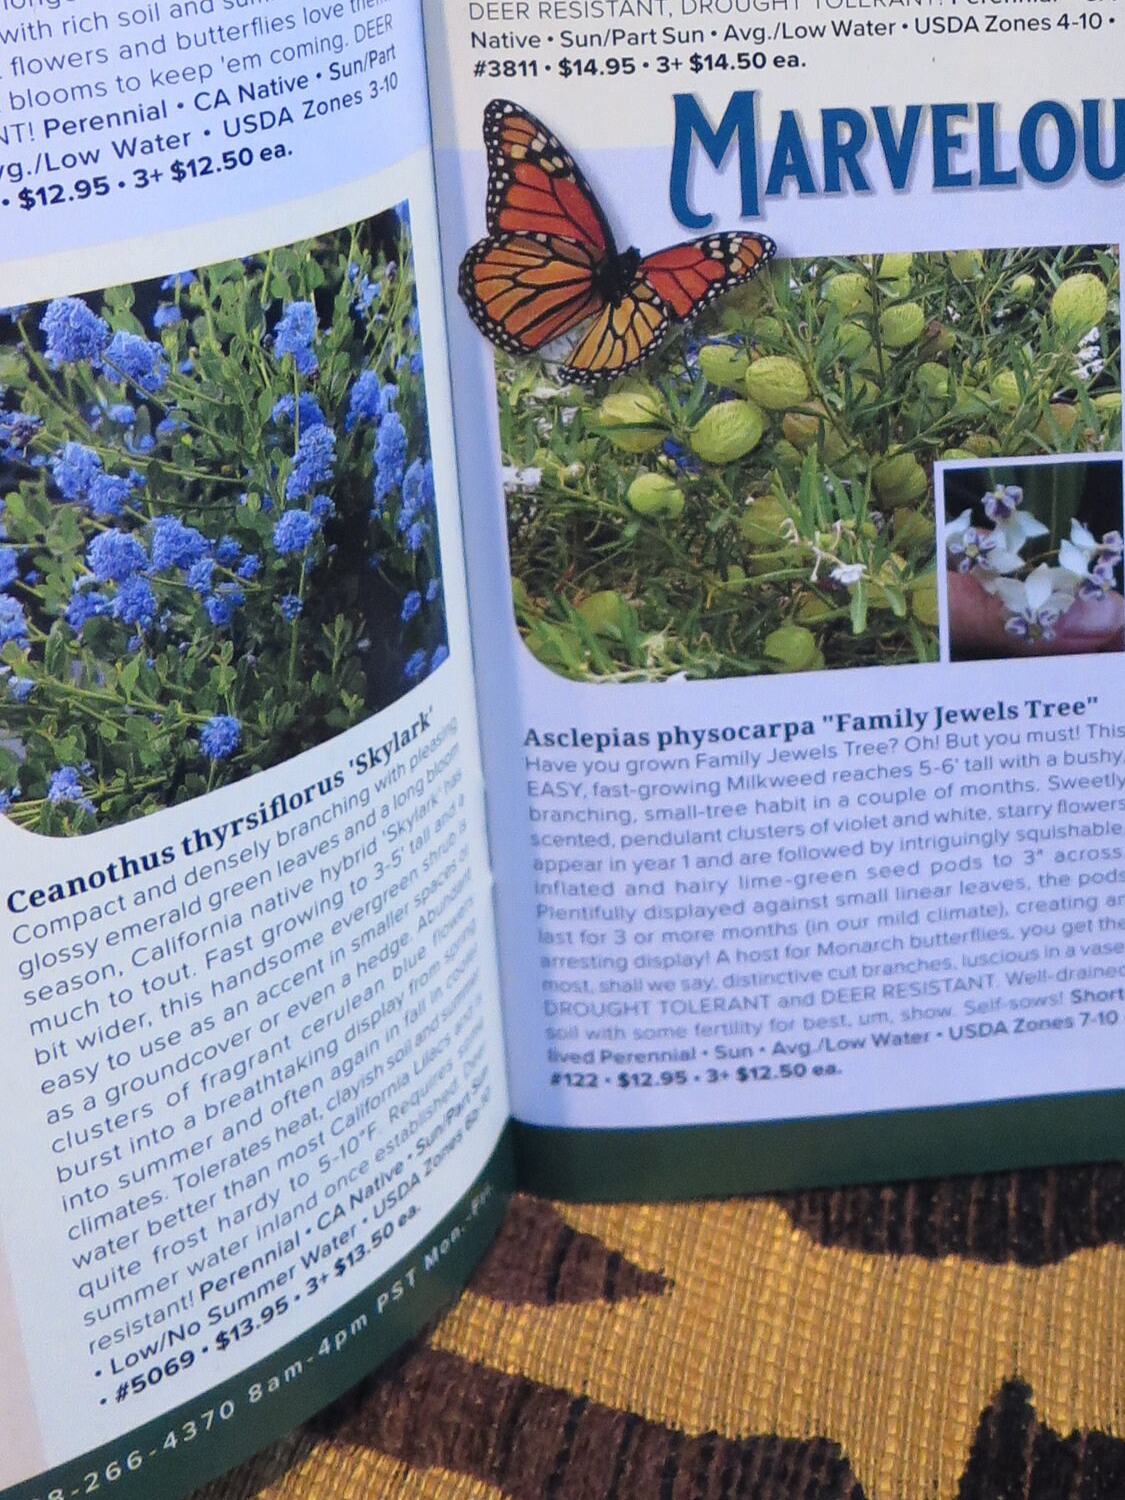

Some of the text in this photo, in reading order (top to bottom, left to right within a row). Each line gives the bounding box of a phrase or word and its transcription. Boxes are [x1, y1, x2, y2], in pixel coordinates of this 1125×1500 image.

[8, 12, 392, 111] blooms to keep 'em coming. DEER
[10, 47, 108, 76] flowers
[119, 33, 166, 59] and
[175, 14, 296, 49] butterflies
[302, 2, 344, 25] love
[473, 51, 806, 78] #3811 $14.95 3+ $14.50 ea.
[17, 143, 292, 211] $12.95 3+ $12.50 ea.
[523, 696, 1098, 753] Asclepias physocarpa "Family Jewels Tree"
[7, 704, 433, 913] Ceanothus thyrsiflorus 'Skylark'
[592, 779, 720, 798] fast-growing
[727, 769, 826, 791] Milkweed
[832, 764, 913, 783] reaches
[964, 755, 993, 772] tall
[999, 752, 1040, 769] with
[1046, 754, 1057, 767] a
[115, 1350, 195, 1403] #5069
[215, 1300, 289, 1351] $13.95
[306, 1273, 331, 1296] 3+
[334, 1222, 394, 1277] $13.50
[374, 1266, 417, 1316] PST
